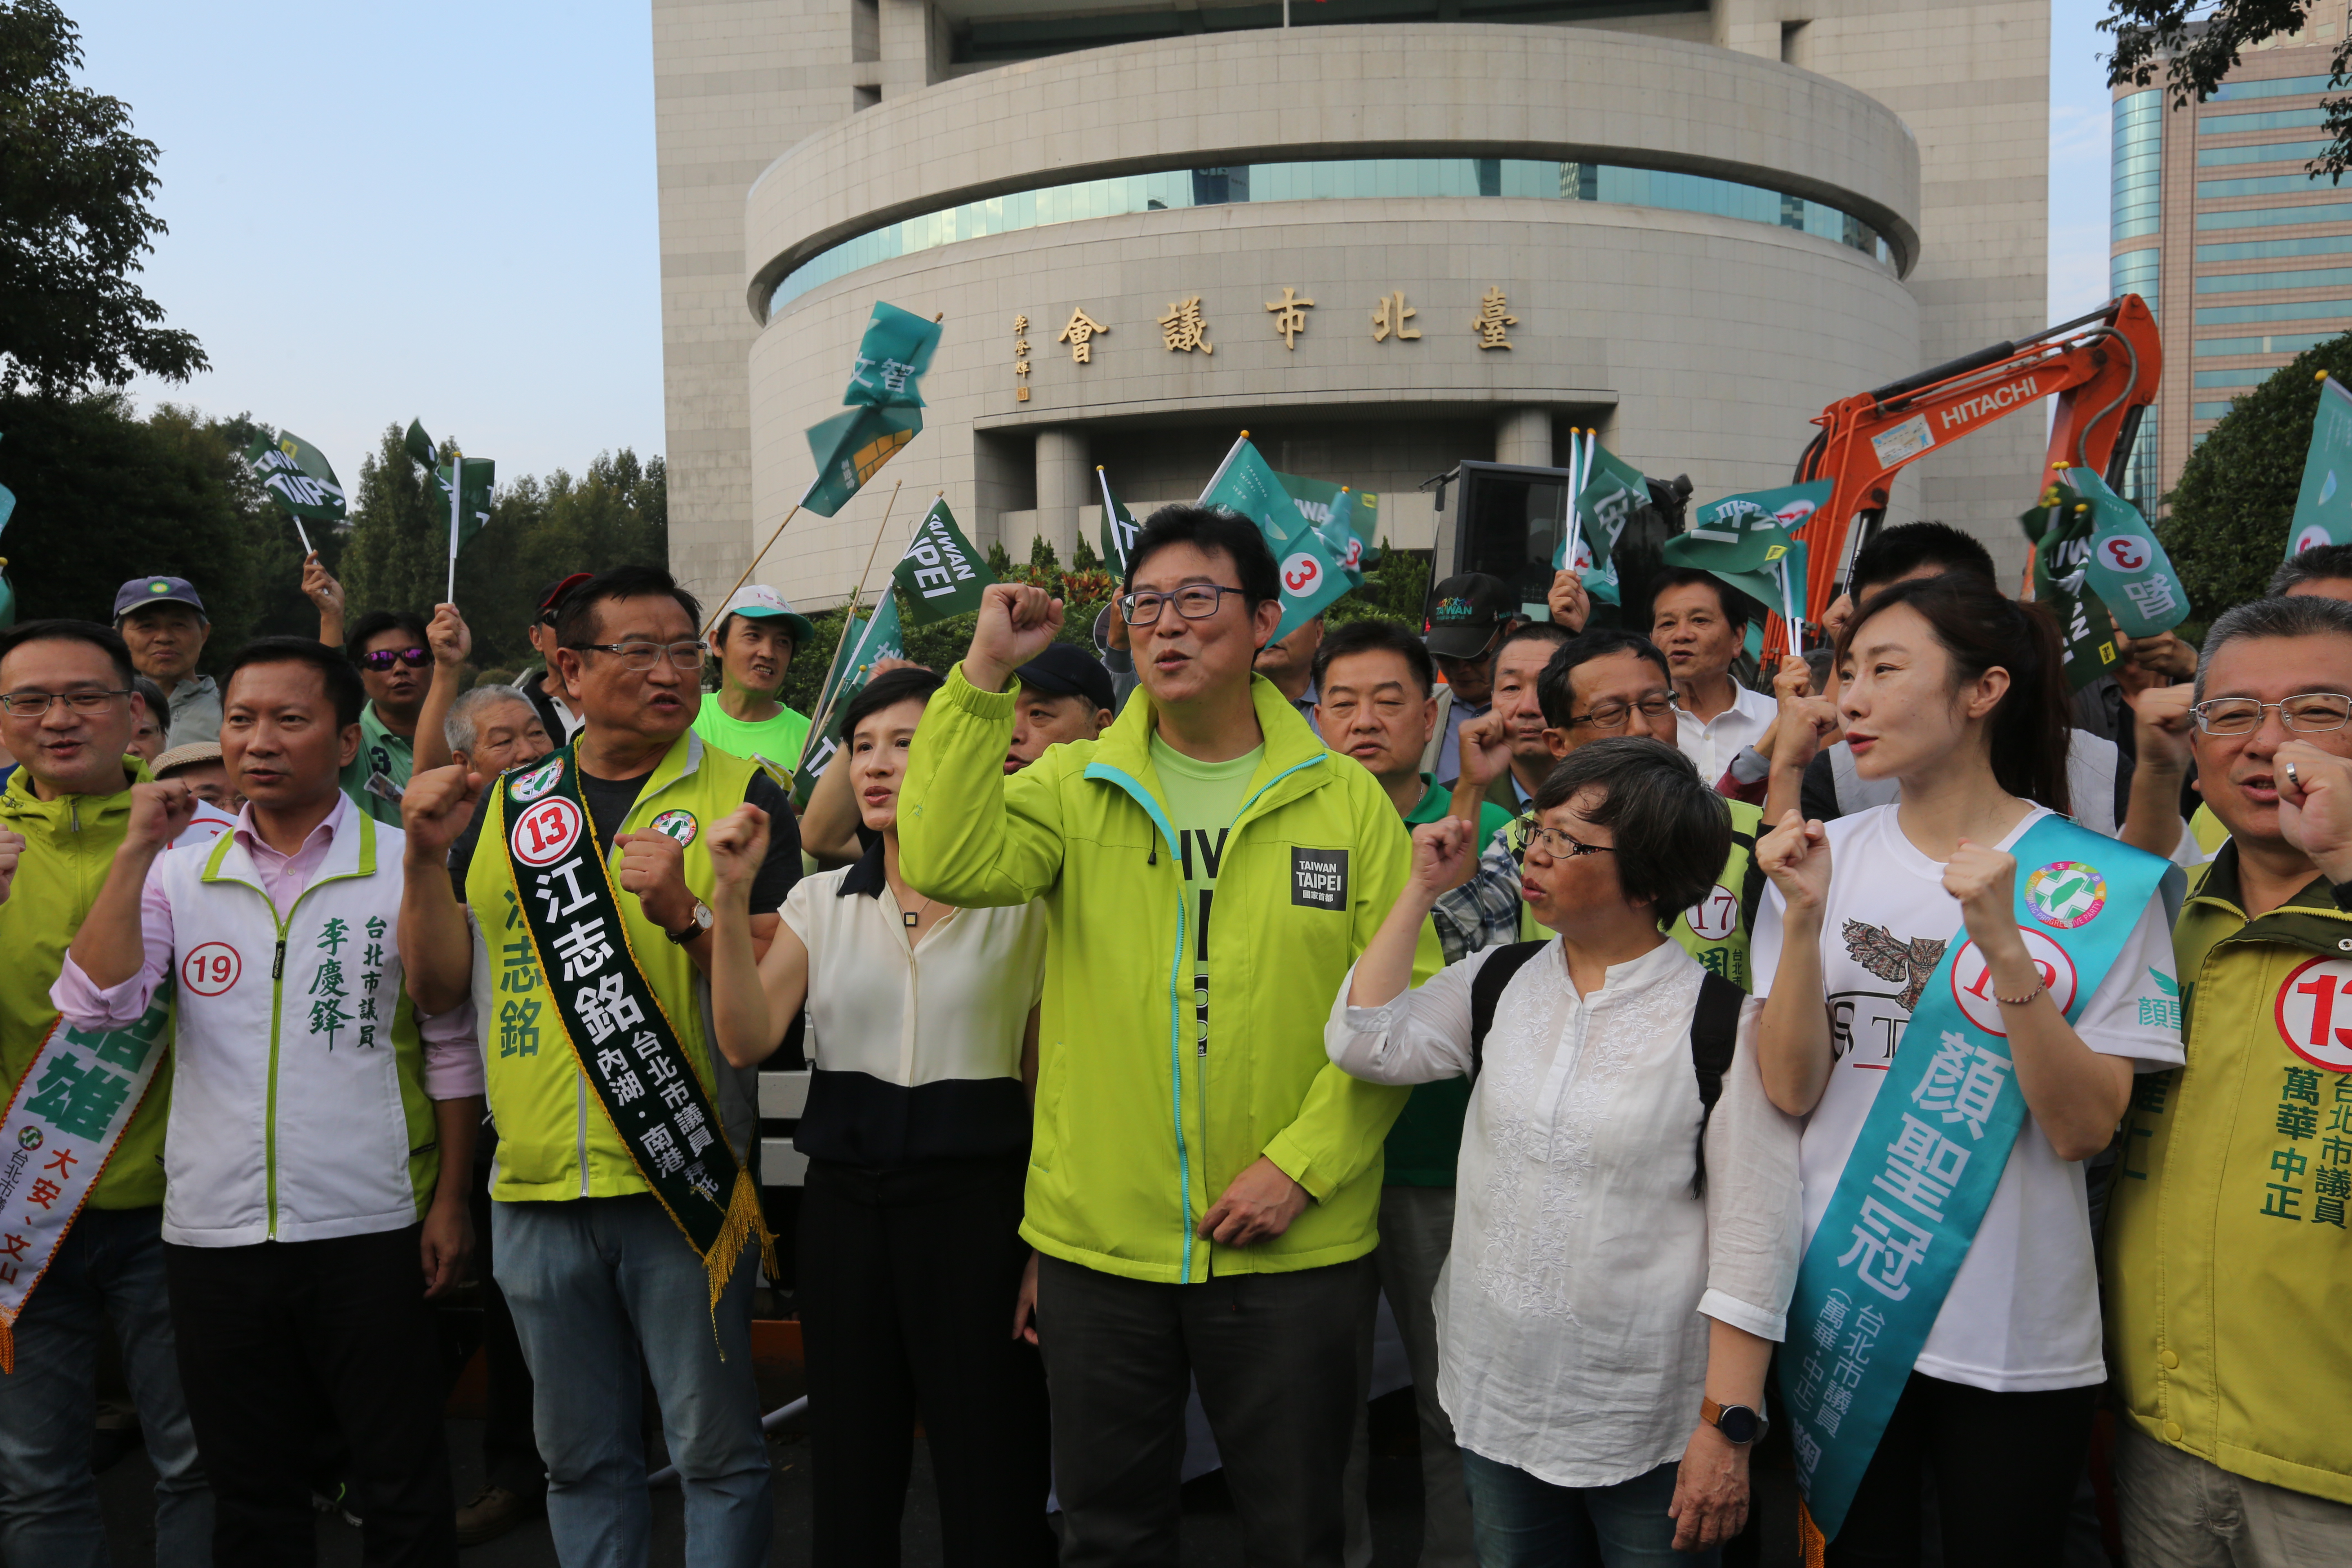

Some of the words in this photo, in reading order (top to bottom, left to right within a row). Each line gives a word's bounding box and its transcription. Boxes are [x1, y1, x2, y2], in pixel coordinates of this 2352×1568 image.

[1013, 314, 1031, 378] 李登輝
[1941, 376, 2038, 429] HITACHI
[1239, 472, 1256, 492] TAIPEI
[1246, 465, 1267, 498] TRENDING
[927, 513, 976, 581] TAIWAN
[1285, 560, 1317, 590] 3
[1436, 605, 1472, 615] TAIWAN
[371, 746, 392, 776] 3
[526, 807, 568, 853] 13
[1296, 871, 1341, 891] TAIPEI
[1299, 860, 1336, 873] TAIWAN
[1303, 890, 1334, 902] 國家首都
[1693, 896, 1733, 931] 17
[2037, 912, 2084, 927] PROGRESSIVE
[2083, 902, 2101, 920] PARTY
[535, 856, 646, 1046] 江志銘
[193, 956, 231, 983] 19
[307, 918, 355, 1053] 李慶鋒
[357, 915, 387, 1049] 台北市議員
[632, 1030, 714, 1157] 台北市議員
[683, 1160, 719, 1201] 拜託
[1837, 1030, 2013, 1301] 顏聖冠
[1814, 1305, 1886, 1439] 台北市議員
